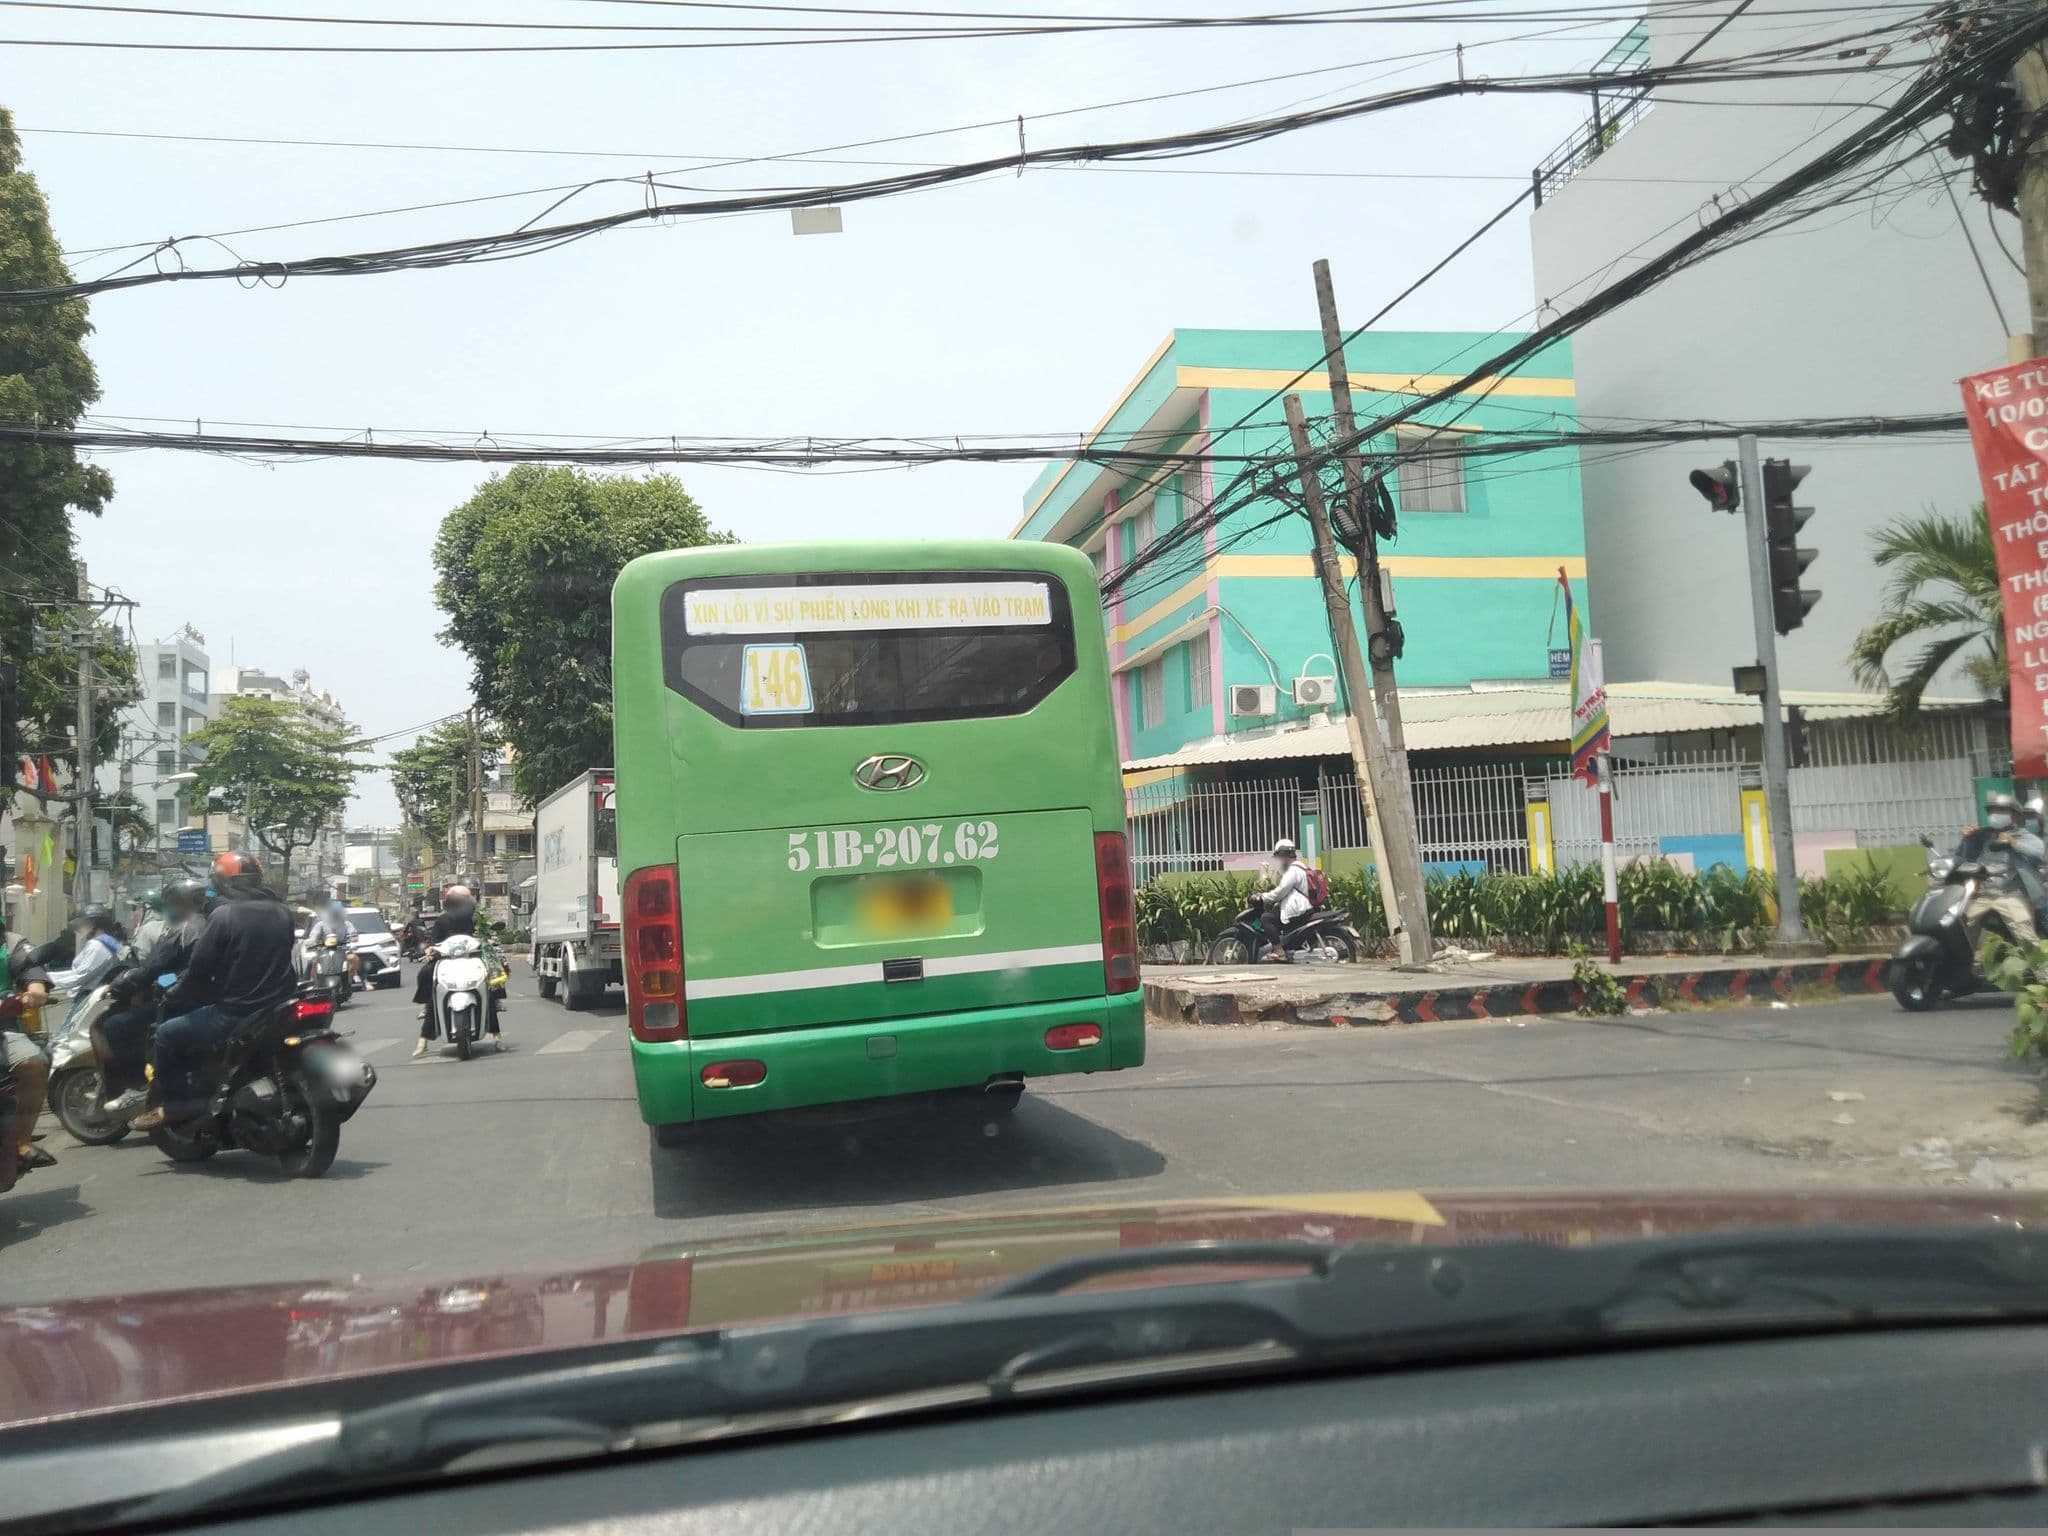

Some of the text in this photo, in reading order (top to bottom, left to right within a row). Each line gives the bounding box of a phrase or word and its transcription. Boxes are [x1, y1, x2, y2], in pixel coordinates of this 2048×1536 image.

[693, 602, 719, 624] XIN
[895, 599, 920, 618] KHI
[926, 598, 944, 617] XE
[948, 597, 969, 617] RA
[748, 650, 802, 708] 146
[787, 820, 999, 872] 51B-207.62
